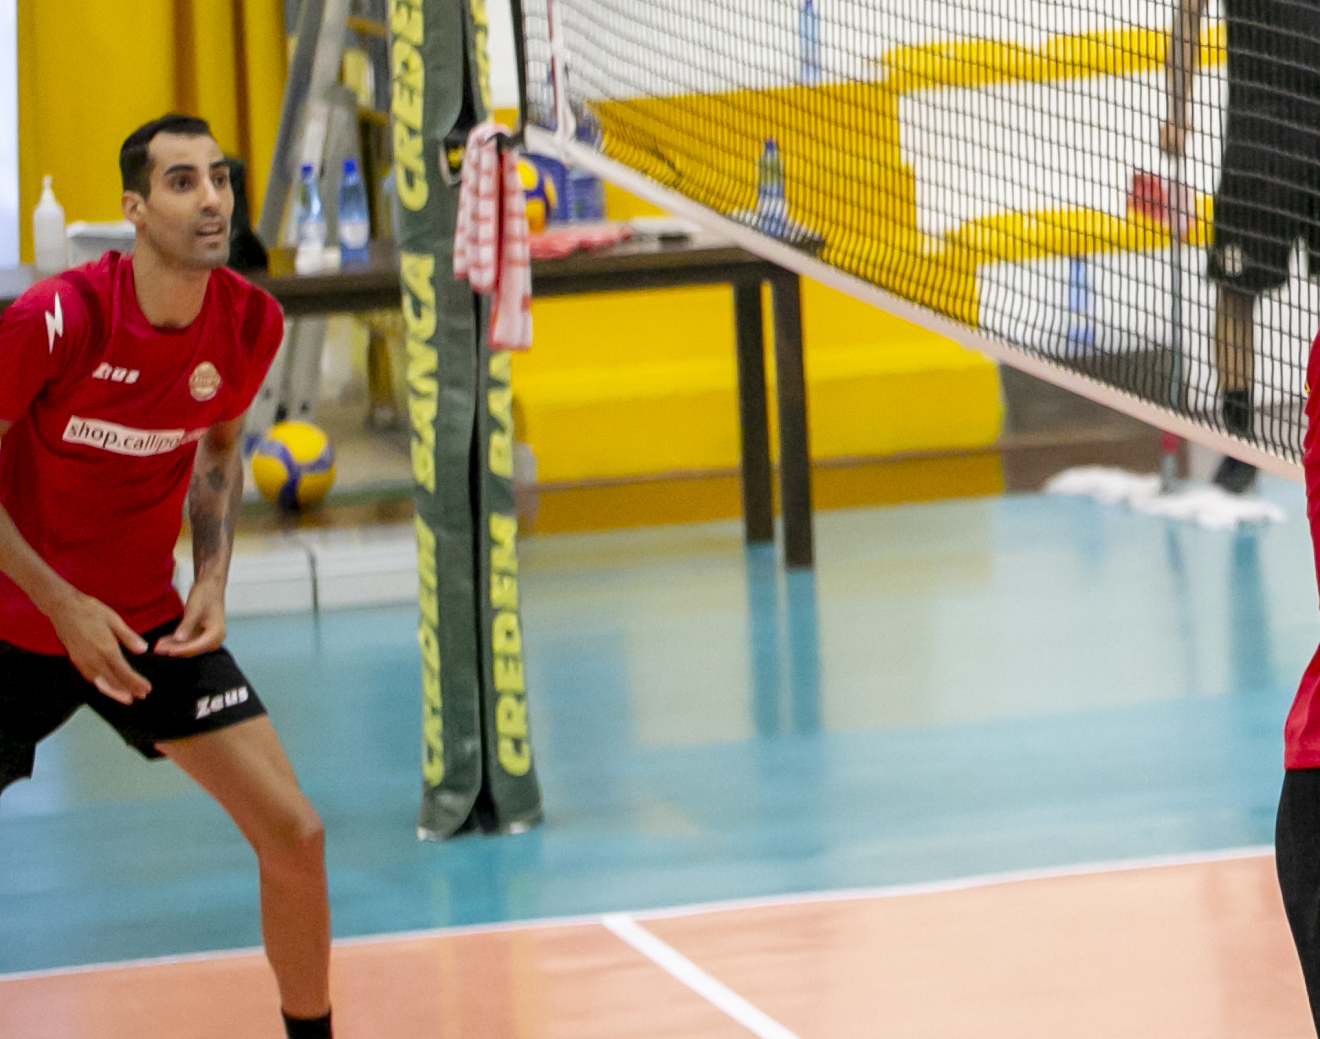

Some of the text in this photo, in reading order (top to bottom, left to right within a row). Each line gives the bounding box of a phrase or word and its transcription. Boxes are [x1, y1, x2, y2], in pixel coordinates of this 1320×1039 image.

[400, 252, 446, 787] CREDEM BANCA
[490, 512, 532, 777] CREDEM
[195, 686, 249, 720] Zeus
